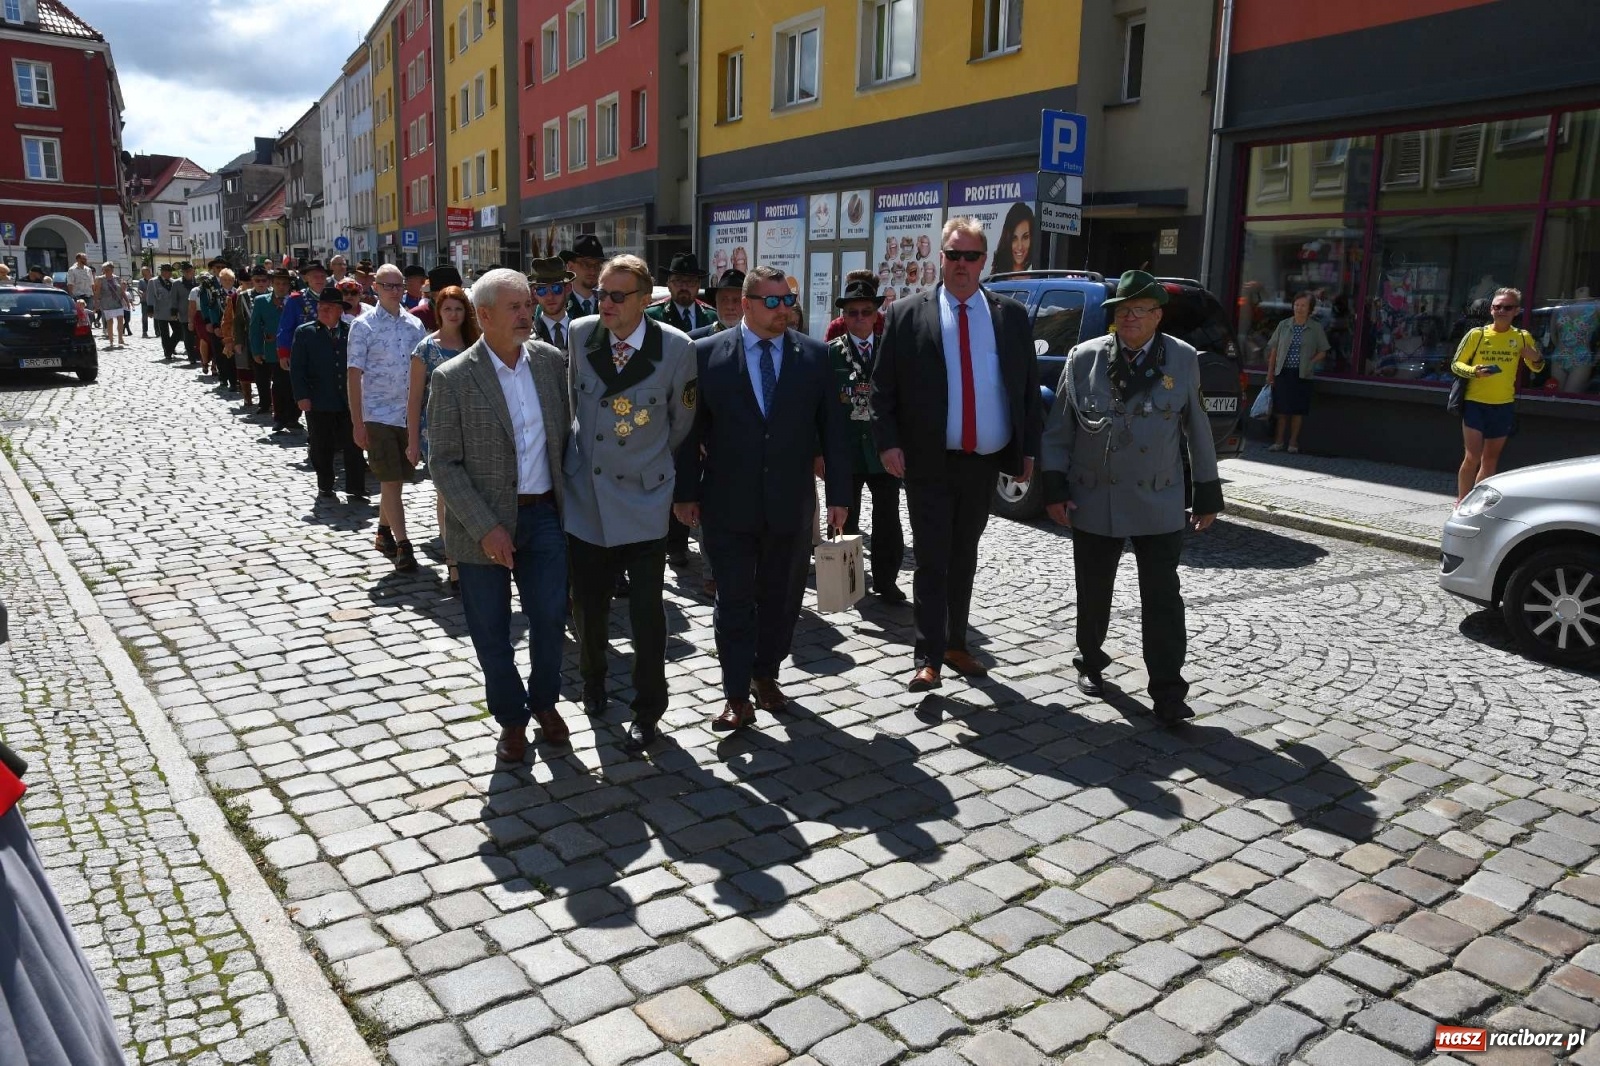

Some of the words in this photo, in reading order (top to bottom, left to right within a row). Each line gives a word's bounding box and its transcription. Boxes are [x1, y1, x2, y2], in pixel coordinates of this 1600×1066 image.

[1051, 118, 1078, 165] P
[965, 182, 1021, 202] PROTETYKA
[878, 190, 939, 209] STOMATOLOGIA
[713, 208, 751, 222] STOMATOLOGIA
[765, 204, 798, 218] PROTETYKA
[1042, 207, 1053, 217] dla
[144, 223, 155, 237] P
[405, 232, 415, 245] P
[1163, 236, 1175, 248] 52
